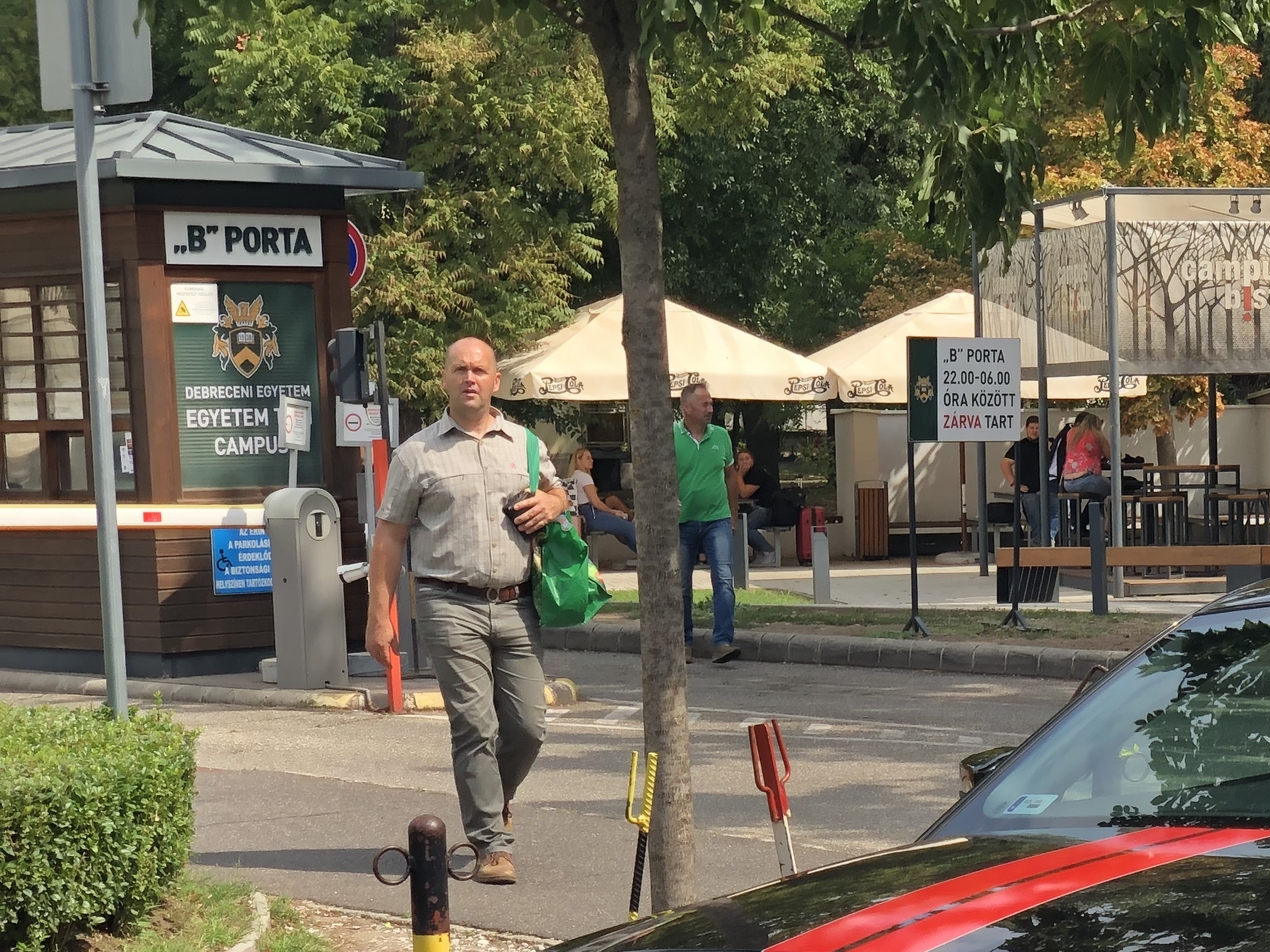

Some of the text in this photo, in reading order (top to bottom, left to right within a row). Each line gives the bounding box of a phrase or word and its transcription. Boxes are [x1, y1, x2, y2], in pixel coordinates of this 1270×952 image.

[224, 226, 313, 255] PORTA
[967, 348, 1005, 363] PORTA
[943, 370, 1010, 385] 22.00-06.00
[185, 384, 311, 400] DEBRECENI EGYETEM
[943, 388, 1016, 407] ÓRA KÖZÖTT
[186, 407, 269, 429] EGYETEM
[943, 410, 1014, 429] ZÁRVA TART
[228, 540, 233, 549] A
[224, 566, 230, 575] A
